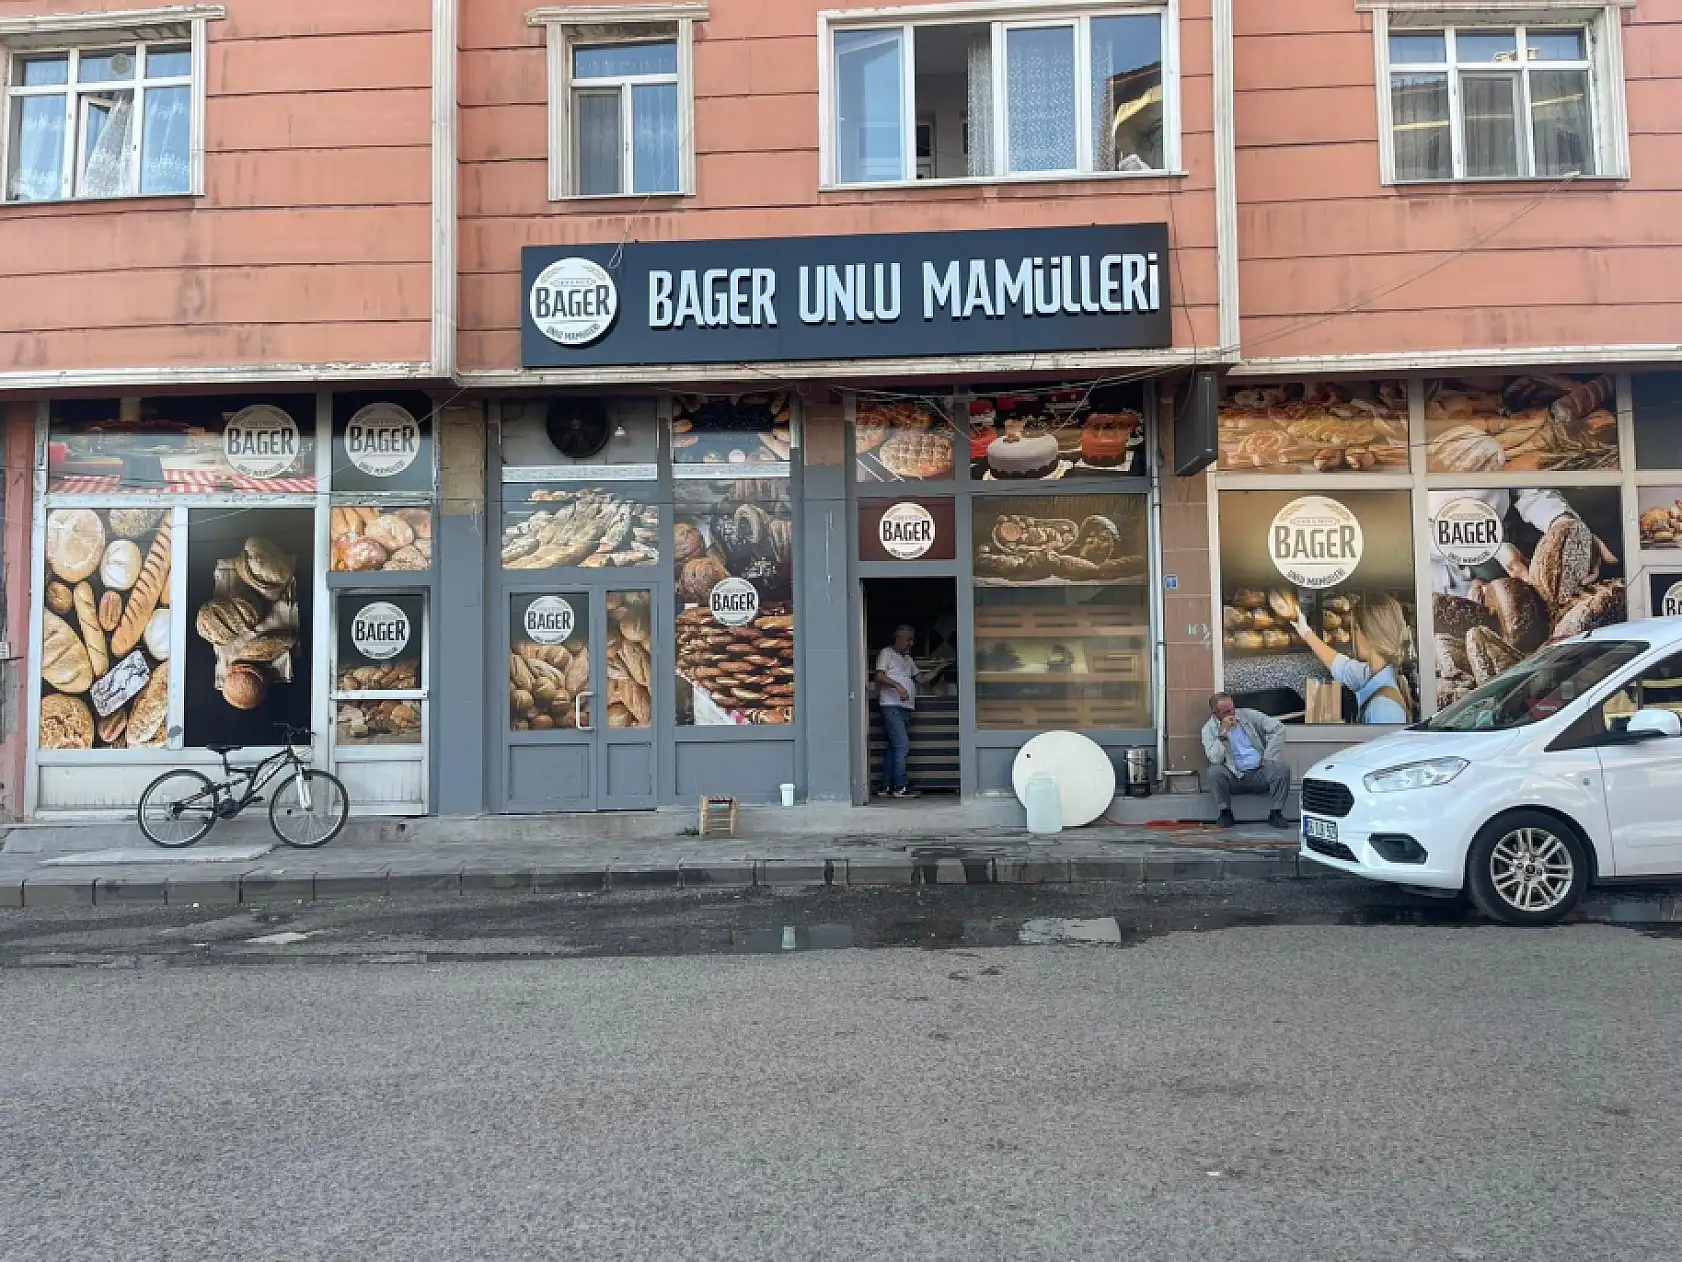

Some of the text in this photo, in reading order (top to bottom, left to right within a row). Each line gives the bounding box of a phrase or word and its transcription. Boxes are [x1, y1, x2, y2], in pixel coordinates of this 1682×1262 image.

[535, 284, 611, 319] BAGER
[649, 251, 1160, 328] BAGER UNLU MAMÜLLERİ
[227, 427, 294, 455] BAGER
[350, 424, 415, 453] BAGER
[882, 520, 932, 541] BAGER
[1274, 525, 1357, 559] BAGER
[1438, 518, 1499, 545] BAGER
[711, 591, 756, 612] BAGER
[355, 619, 406, 641] BAGER
[528, 610, 572, 630] BAGER
